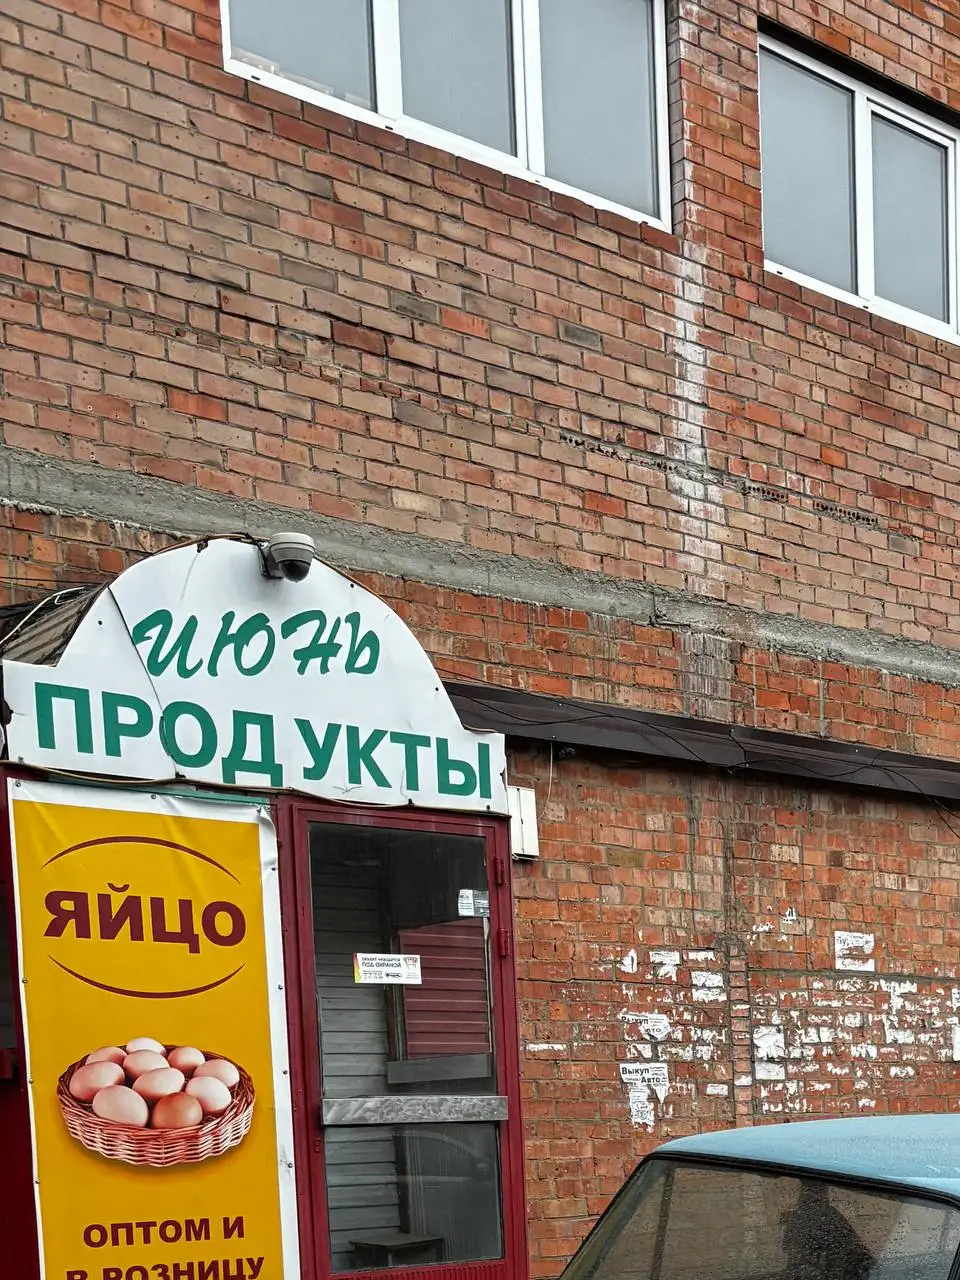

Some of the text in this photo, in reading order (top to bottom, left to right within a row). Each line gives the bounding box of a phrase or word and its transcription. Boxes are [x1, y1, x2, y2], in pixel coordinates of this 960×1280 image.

[132, 608, 380, 679] ИЮНЬ
[34, 681, 493, 800] ПРОДУКТЫ
[43, 882, 247, 955] ЯЙЦО
[621, 1067, 650, 1076] Выкуп
[640, 1076, 661, 1084] Авто
[83, 1216, 245, 1248] ОПТОМ И
